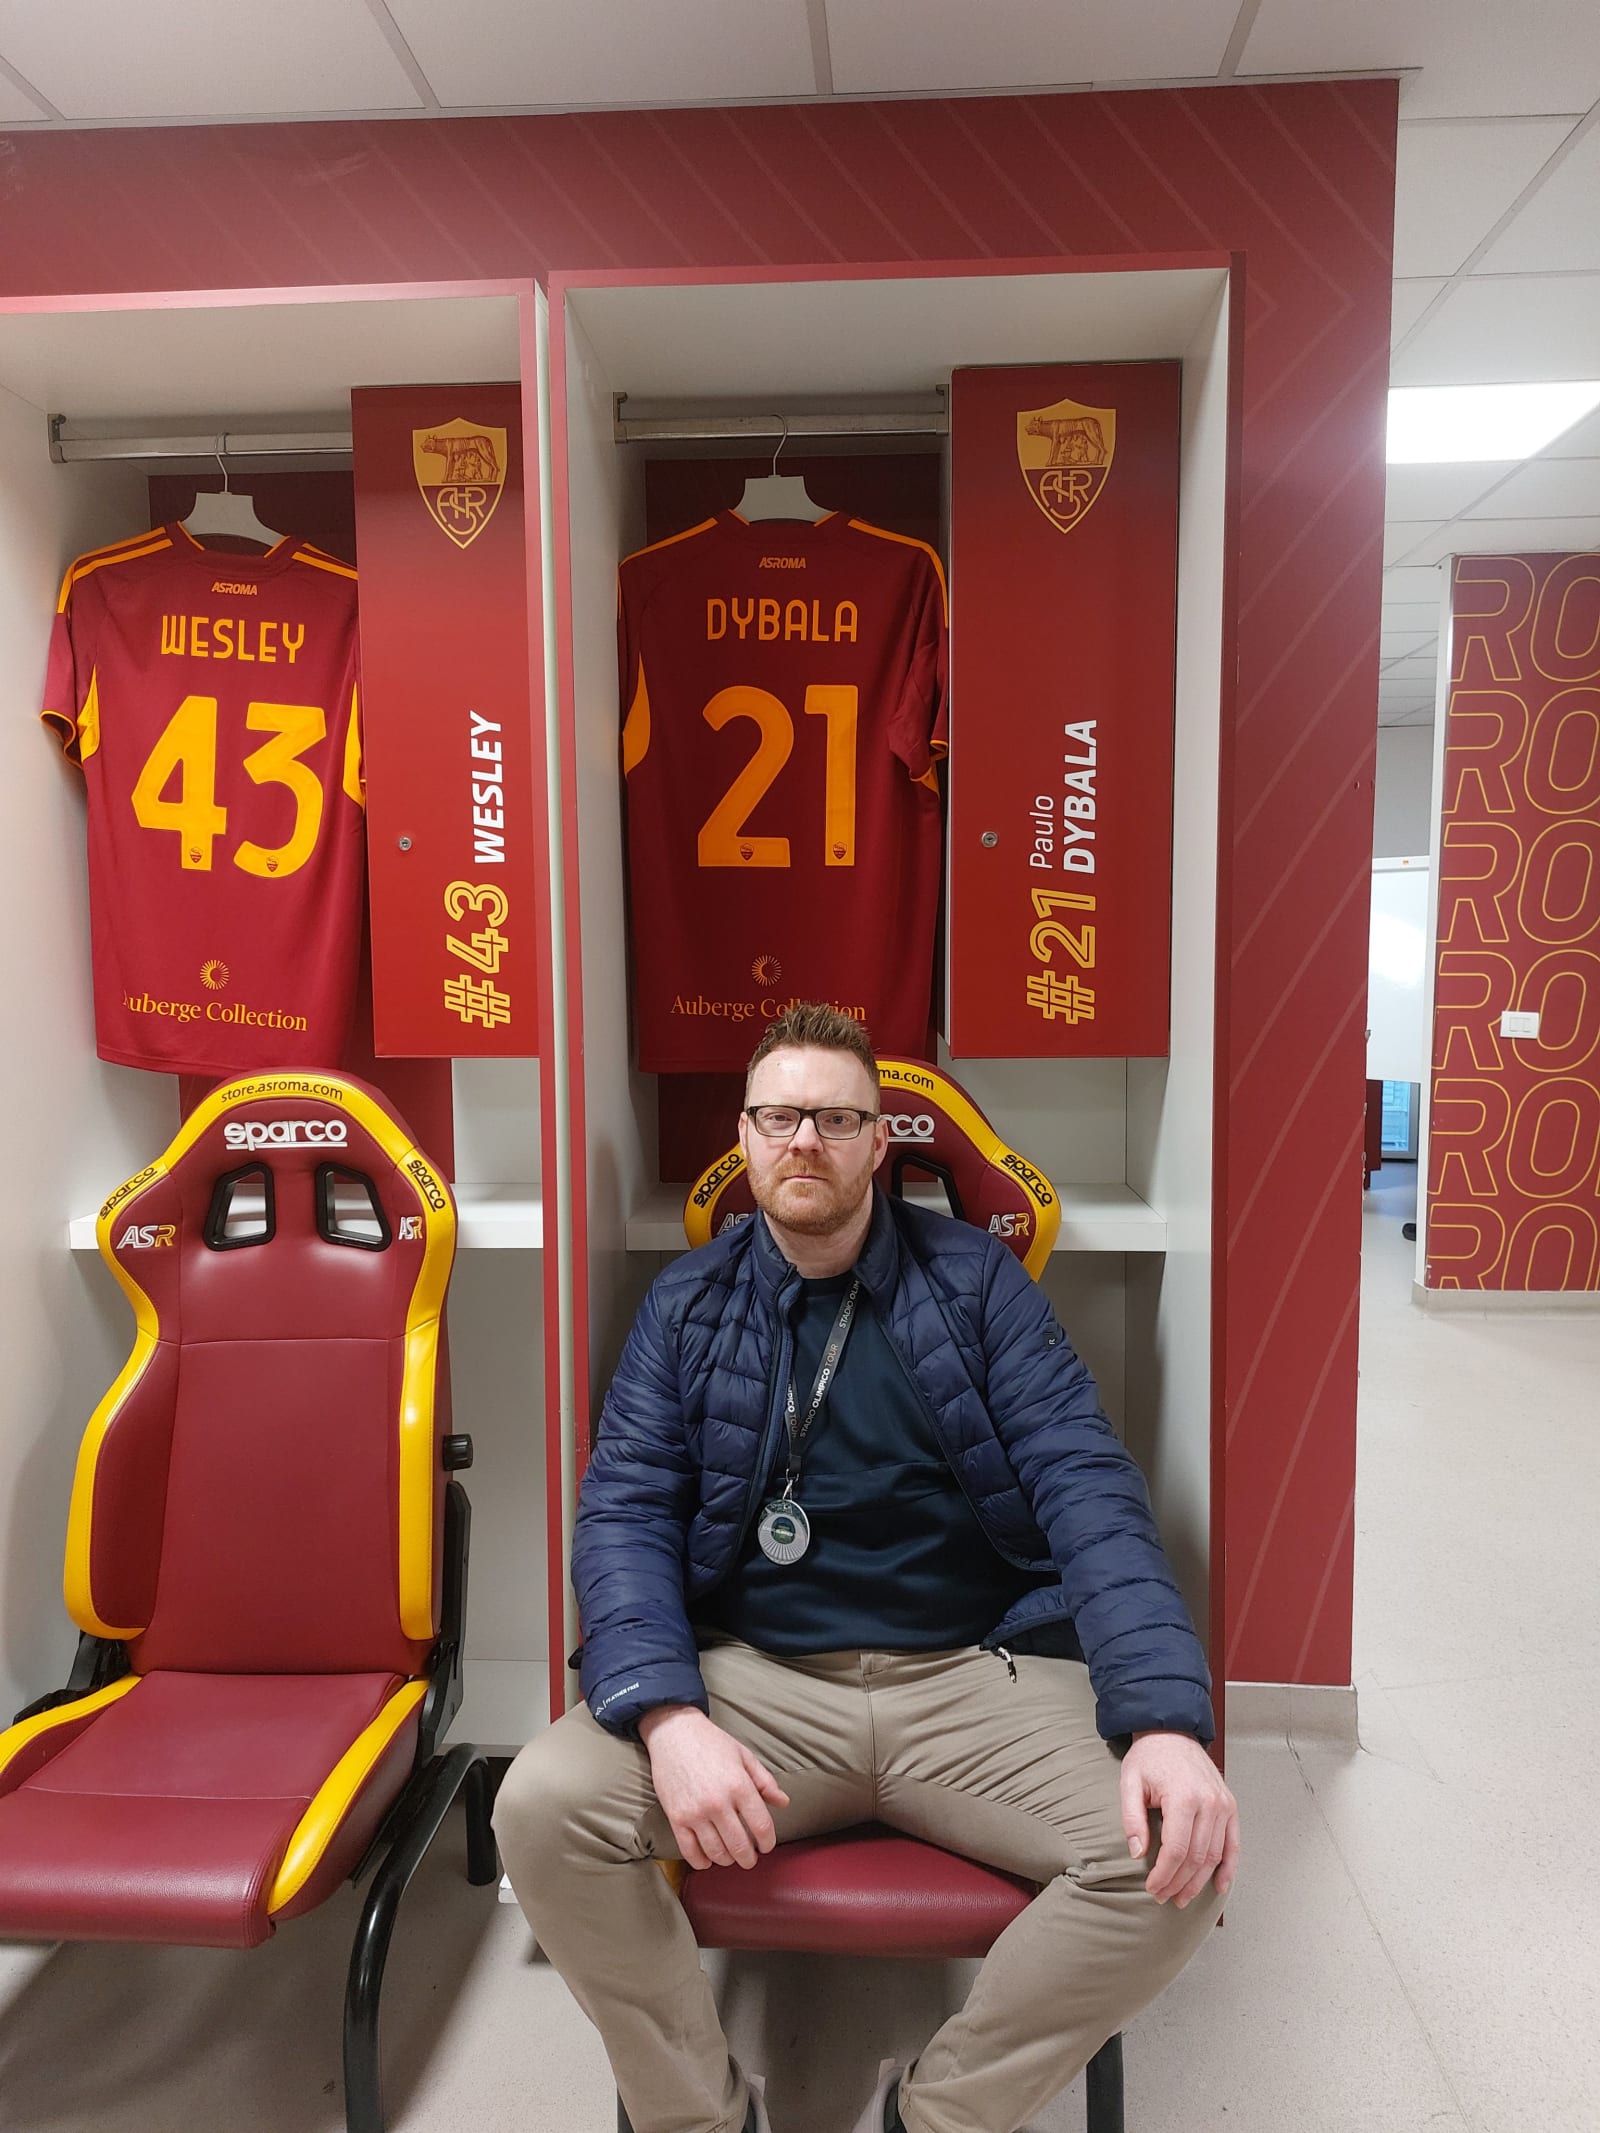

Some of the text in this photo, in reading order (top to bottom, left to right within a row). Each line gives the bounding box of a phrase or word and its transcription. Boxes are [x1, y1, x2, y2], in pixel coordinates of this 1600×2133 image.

[160, 615, 305, 664] WESLEY
[707, 597, 858, 643] DYBALA
[130, 695, 327, 879] 43
[469, 710, 506, 864] WESLEY
[697, 684, 859, 868] 21
[1063, 719, 1097, 874] DYBALA
[1029, 795, 1054, 870] Paulo
[443, 880, 511, 1029] #43
[1026, 887, 1096, 1025] #21
[206, 1002, 307, 1032] Collection
[671, 995, 755, 1023] Auberge
[220, 1080, 343, 1103] store.asroma.com
[223, 1119, 348, 1152] sparco
[1427, 1076, 1600, 1199] RO
[100, 1167, 157, 1220] sparco
[407, 1160, 446, 1212] sparco
[693, 1153, 744, 1208] sparco
[1000, 1154, 1053, 1207] sparco
[116, 1224, 176, 1250] ASR
[398, 1215, 423, 1240] ASR
[988, 1213, 1030, 1237] ASR
[838, 1300, 854, 1329] STADIO
[800, 1343, 839, 1438] STADIO OLIMPICO TOUR
